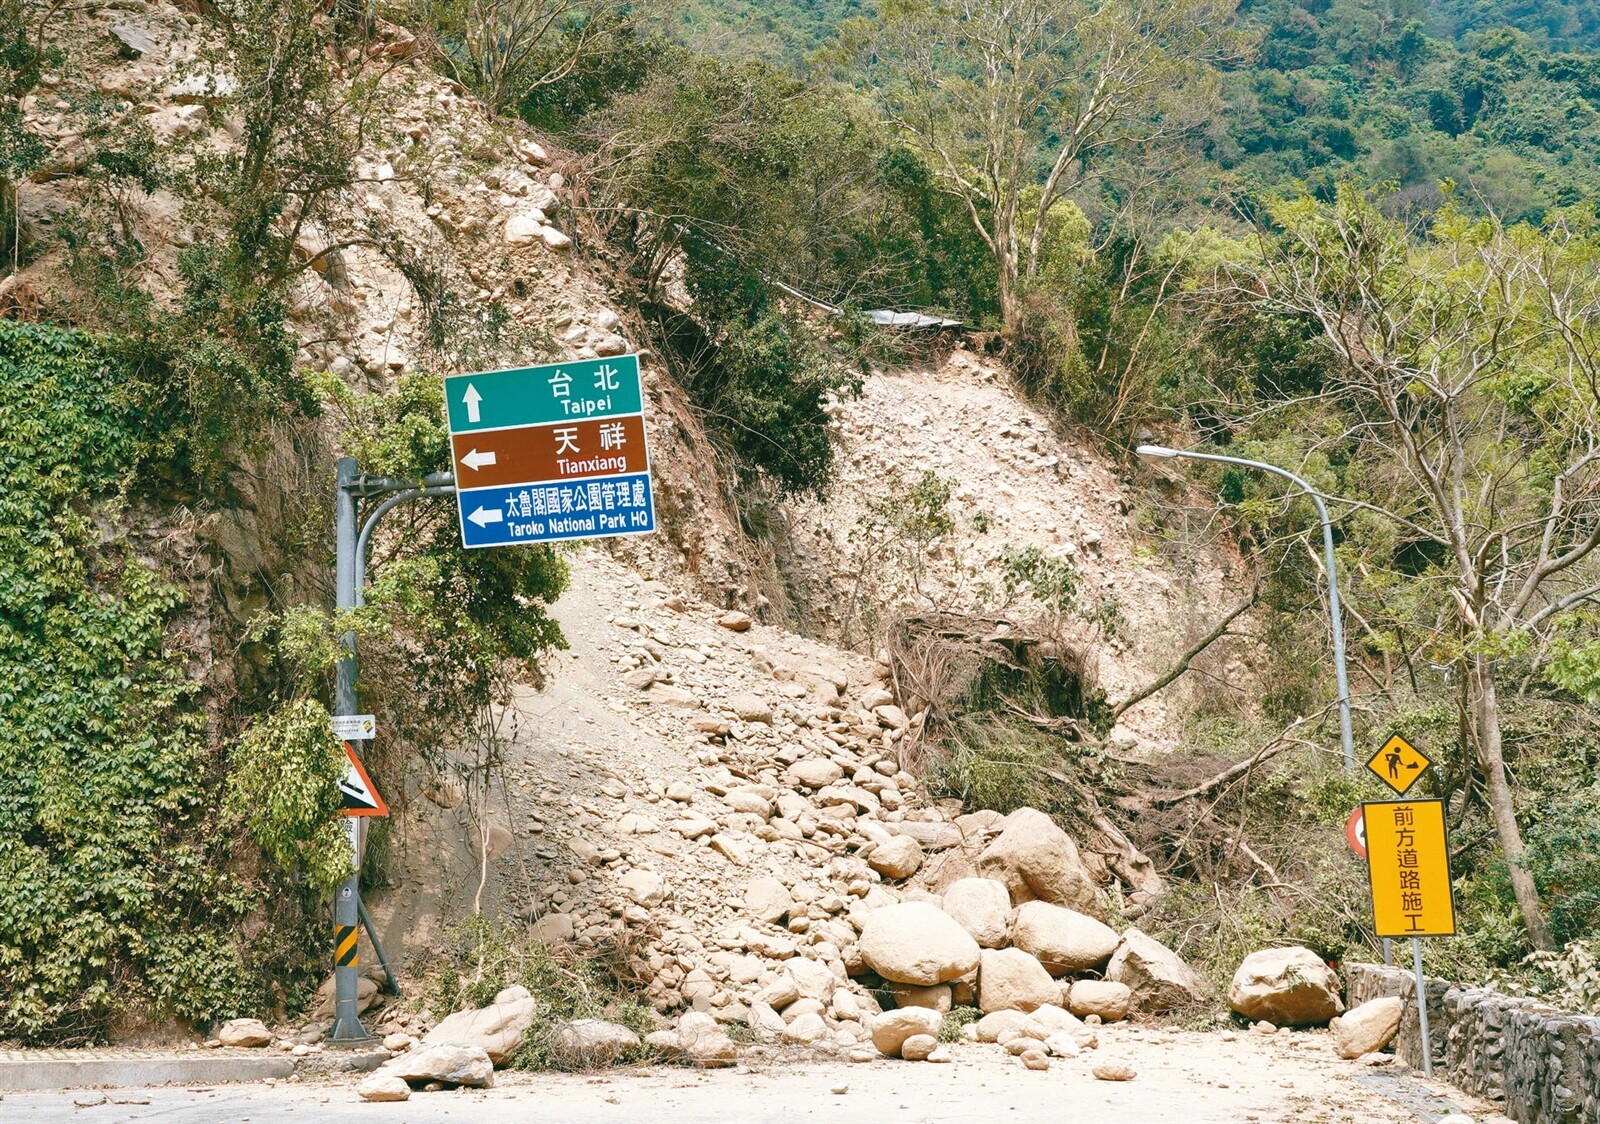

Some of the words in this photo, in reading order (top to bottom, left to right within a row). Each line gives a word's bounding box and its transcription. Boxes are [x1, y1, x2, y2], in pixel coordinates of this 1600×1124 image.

[548, 364, 620, 397] 台北
[561, 395, 612, 416] Taipei
[553, 422, 627, 455] 天祥
[557, 455, 627, 474] Tianxiang
[505, 479, 646, 518] 太魯閣國家公園管理處
[508, 521, 544, 537] Taroko
[549, 516, 595, 534] National
[600, 513, 627, 529] Park
[631, 511, 648, 526] HQ
[1393, 805, 1425, 932] 前方道路施工
